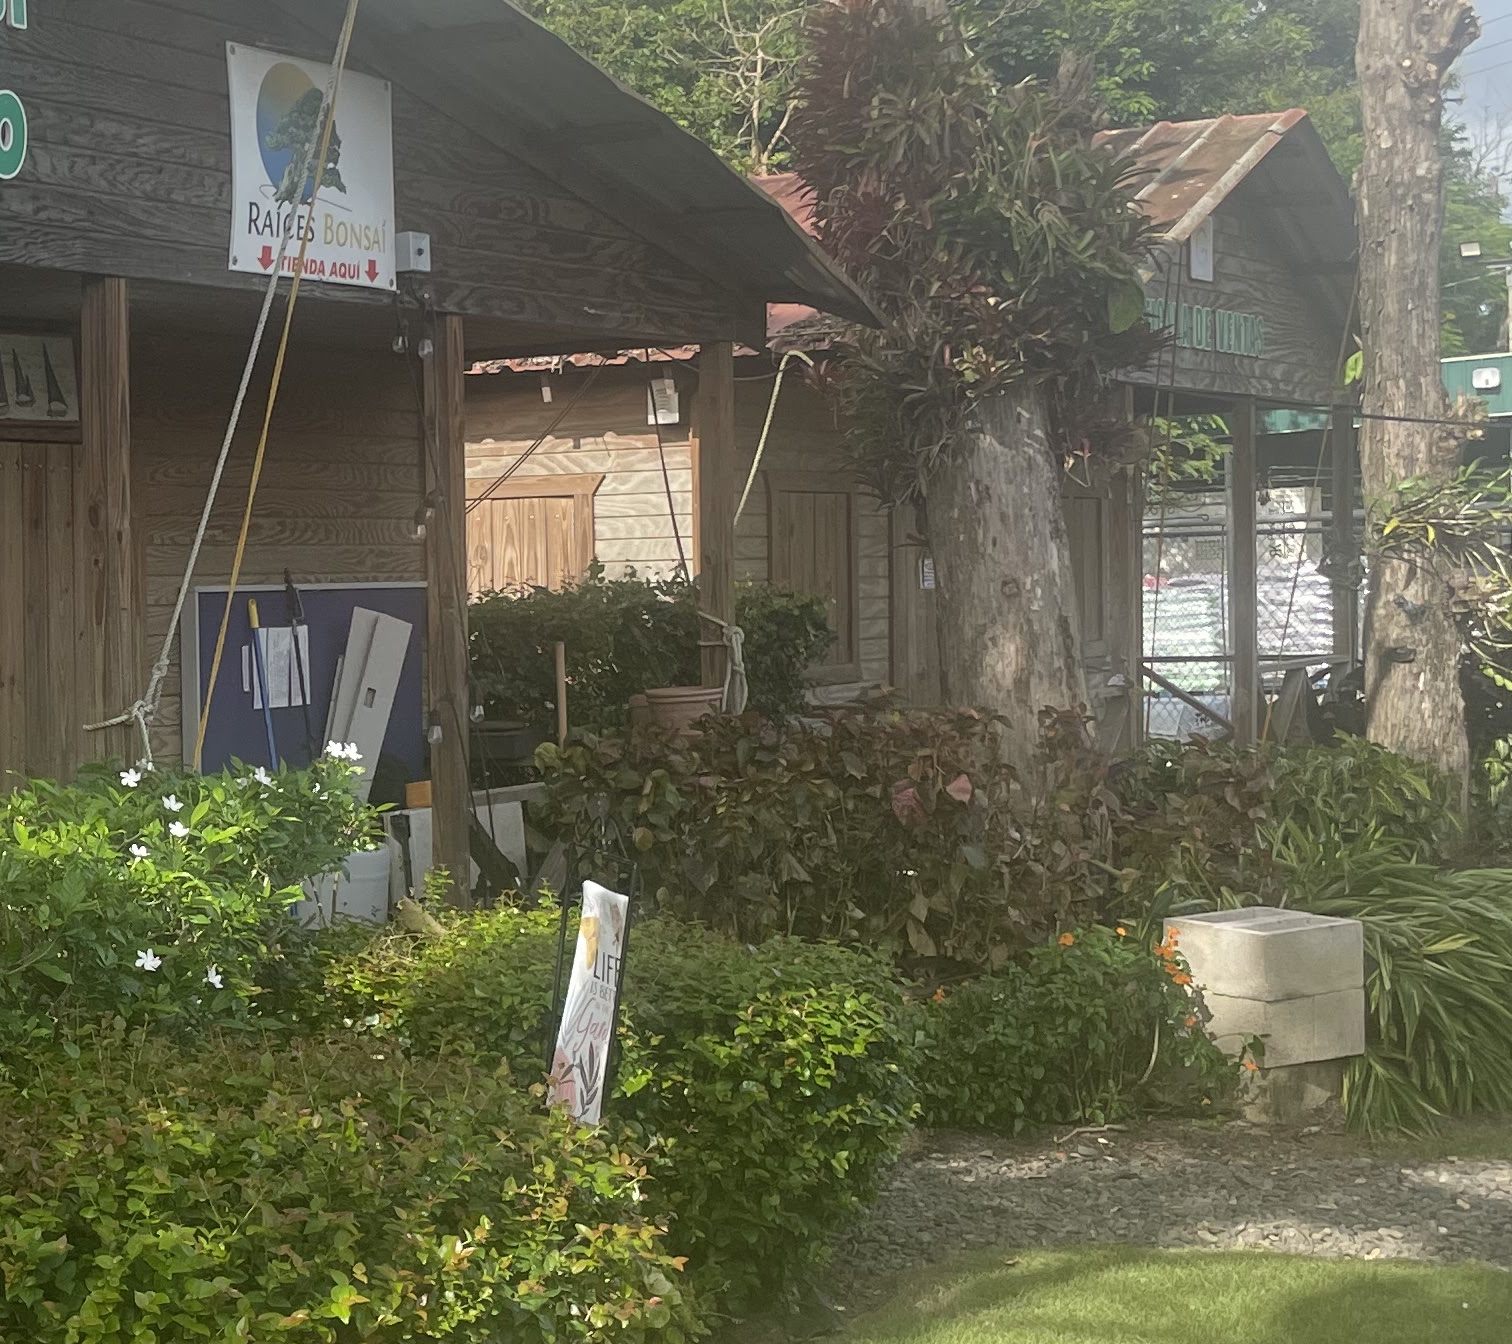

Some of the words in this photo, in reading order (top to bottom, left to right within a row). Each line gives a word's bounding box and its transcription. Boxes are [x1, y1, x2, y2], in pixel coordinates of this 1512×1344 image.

[247, 200, 316, 243] RAÍCES
[322, 212, 387, 254] BONSAÍ
[280, 255, 326, 277] TIENDA
[329, 259, 361, 281] AQUÍ
